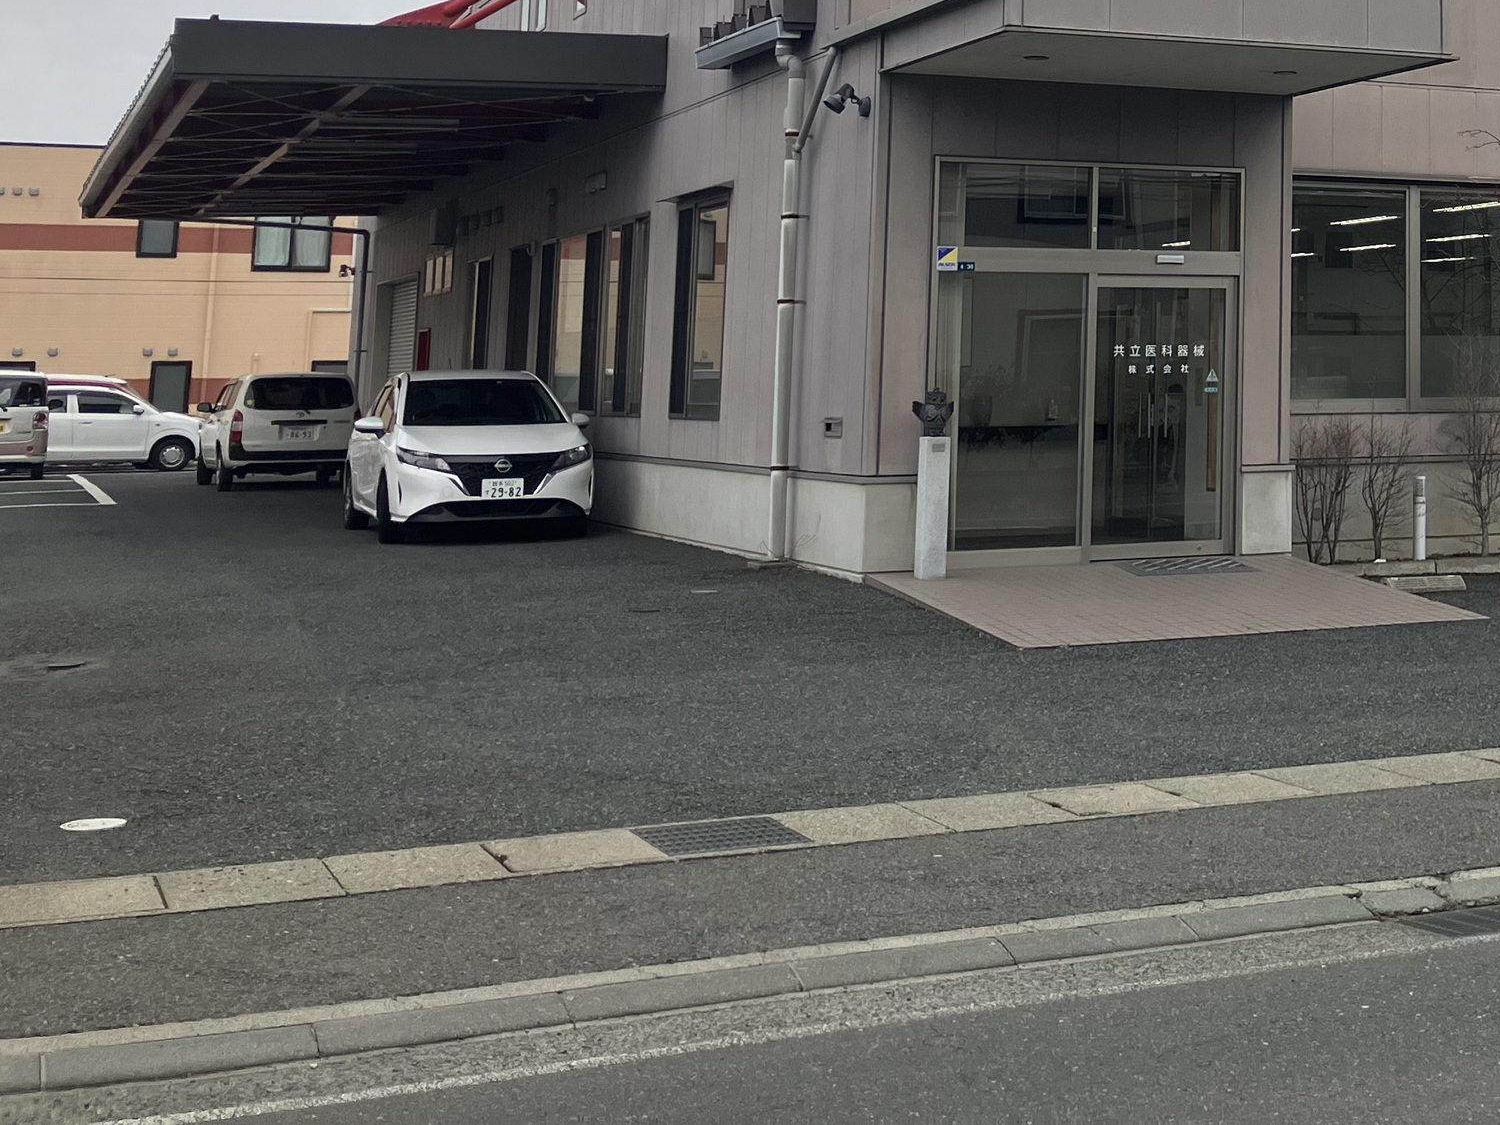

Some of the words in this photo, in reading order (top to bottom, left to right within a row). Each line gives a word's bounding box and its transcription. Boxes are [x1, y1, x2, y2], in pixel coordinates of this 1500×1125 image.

[1113, 344, 1205, 357] 共立医科器械
[1128, 364, 1189, 374] 株式会社
[491, 486, 522, 498] 29-82
